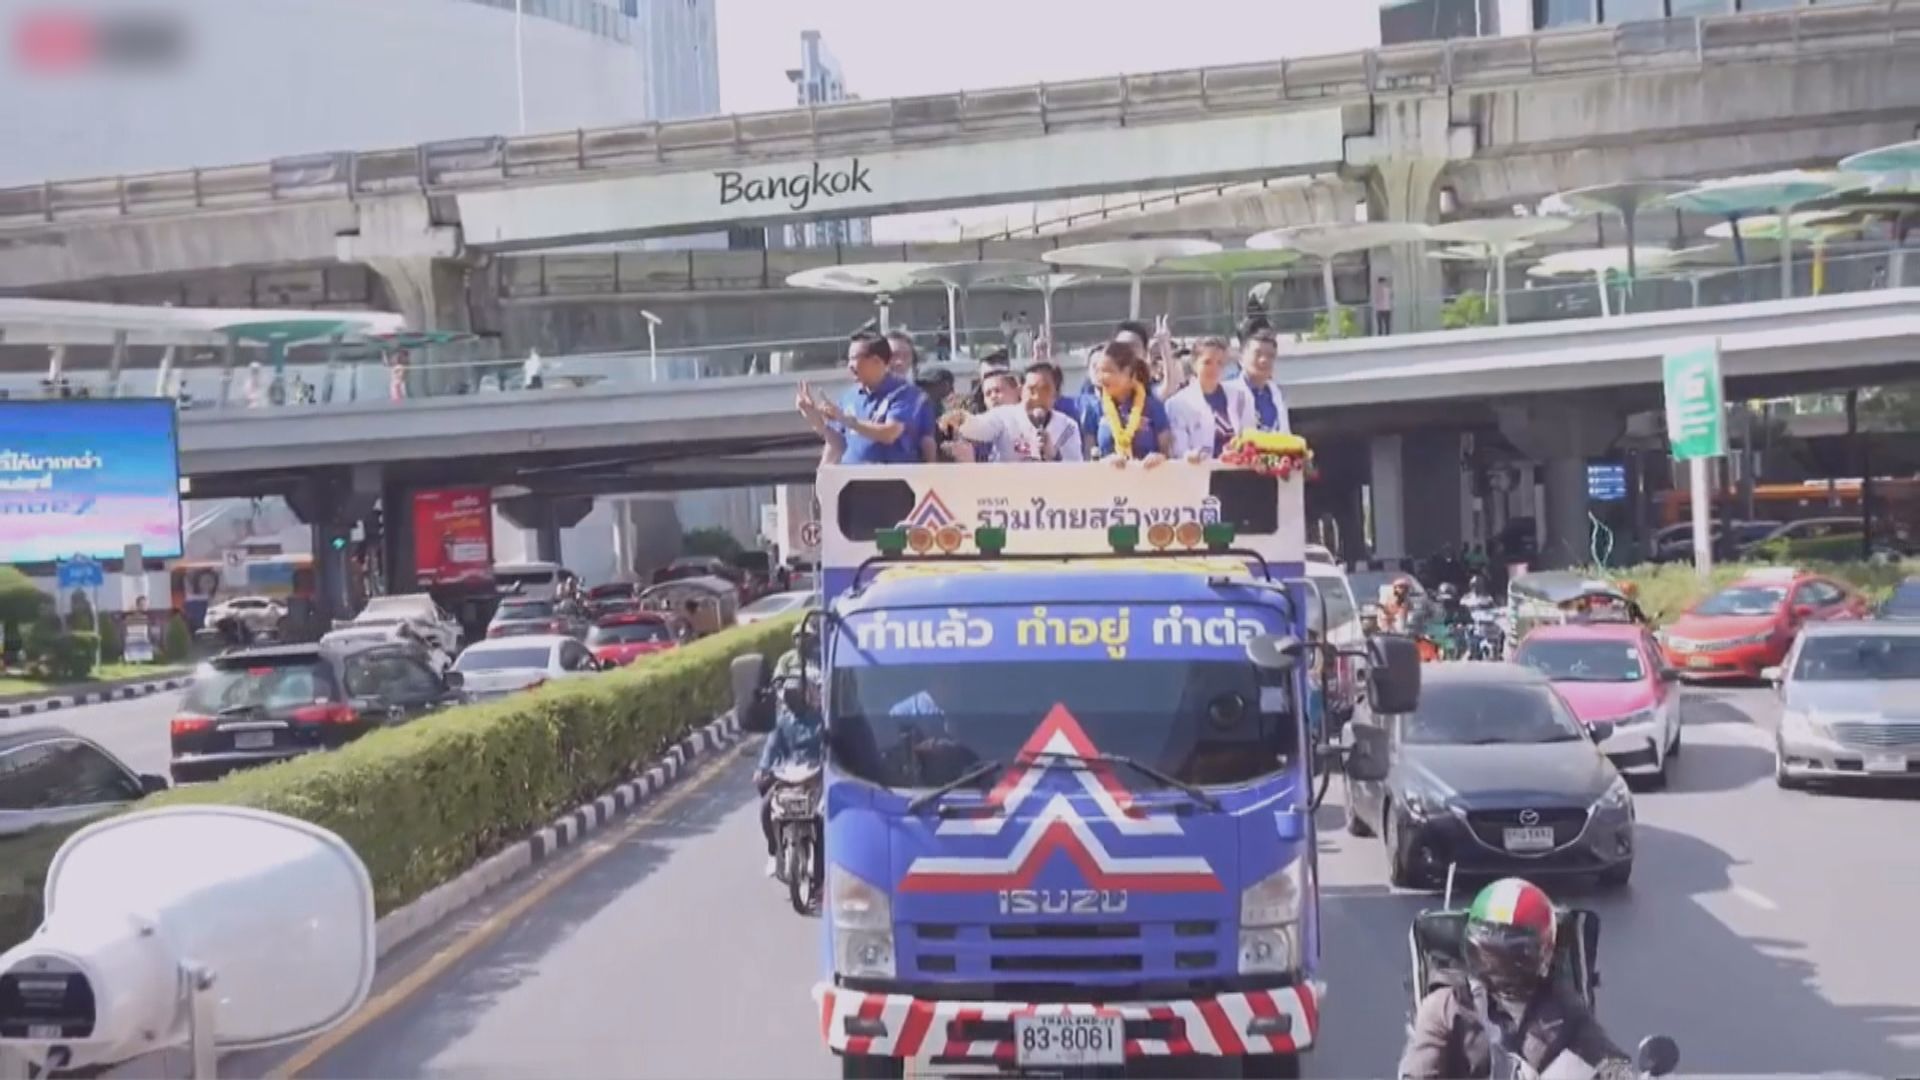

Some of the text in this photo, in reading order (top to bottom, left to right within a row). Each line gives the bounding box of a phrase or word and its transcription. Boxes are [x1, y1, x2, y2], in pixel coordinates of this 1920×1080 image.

[714, 159, 872, 211] Bangkok
[856, 606, 1266, 660] ทำแล้ว ทำอยู่ ทำต่อ
[999, 889, 1127, 914] ISUZU
[1023, 1026, 1113, 1051] 83-8061
